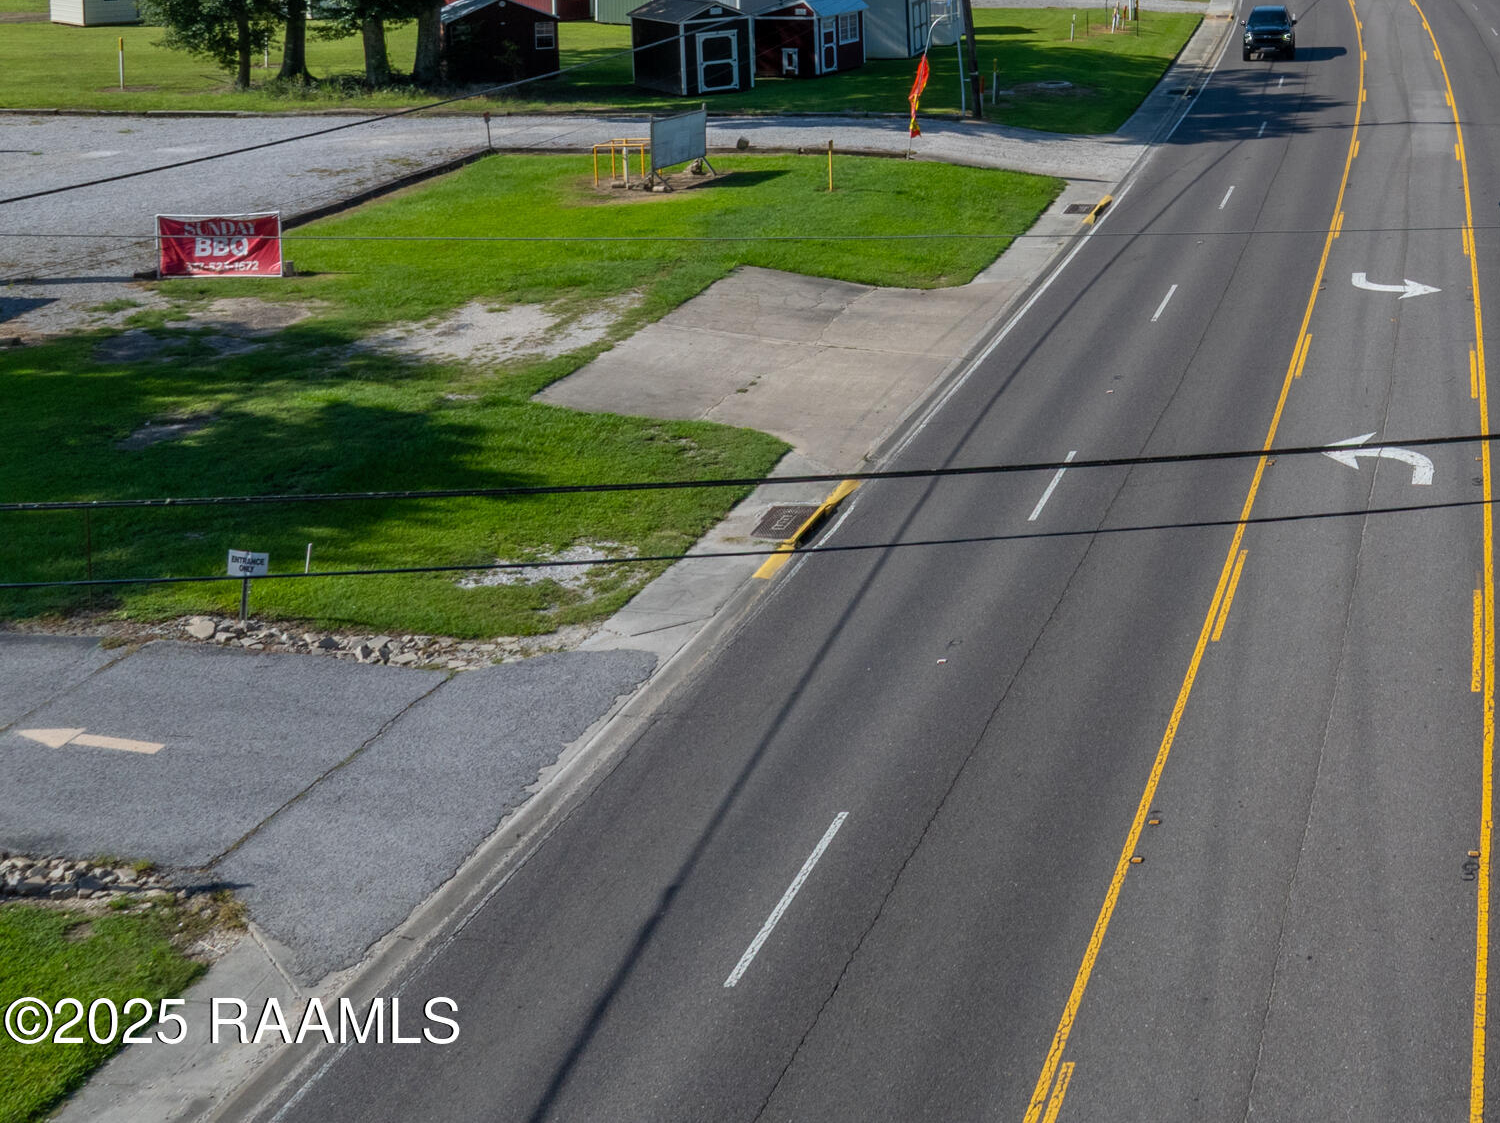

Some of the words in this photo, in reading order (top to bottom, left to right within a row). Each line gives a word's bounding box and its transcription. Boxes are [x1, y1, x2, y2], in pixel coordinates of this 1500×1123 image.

[184, 221, 256, 237] SUNDAY
[194, 236, 249, 257] BBQ
[231, 555, 265, 566] ENTRANCE
[239, 564, 255, 573] ONLY
